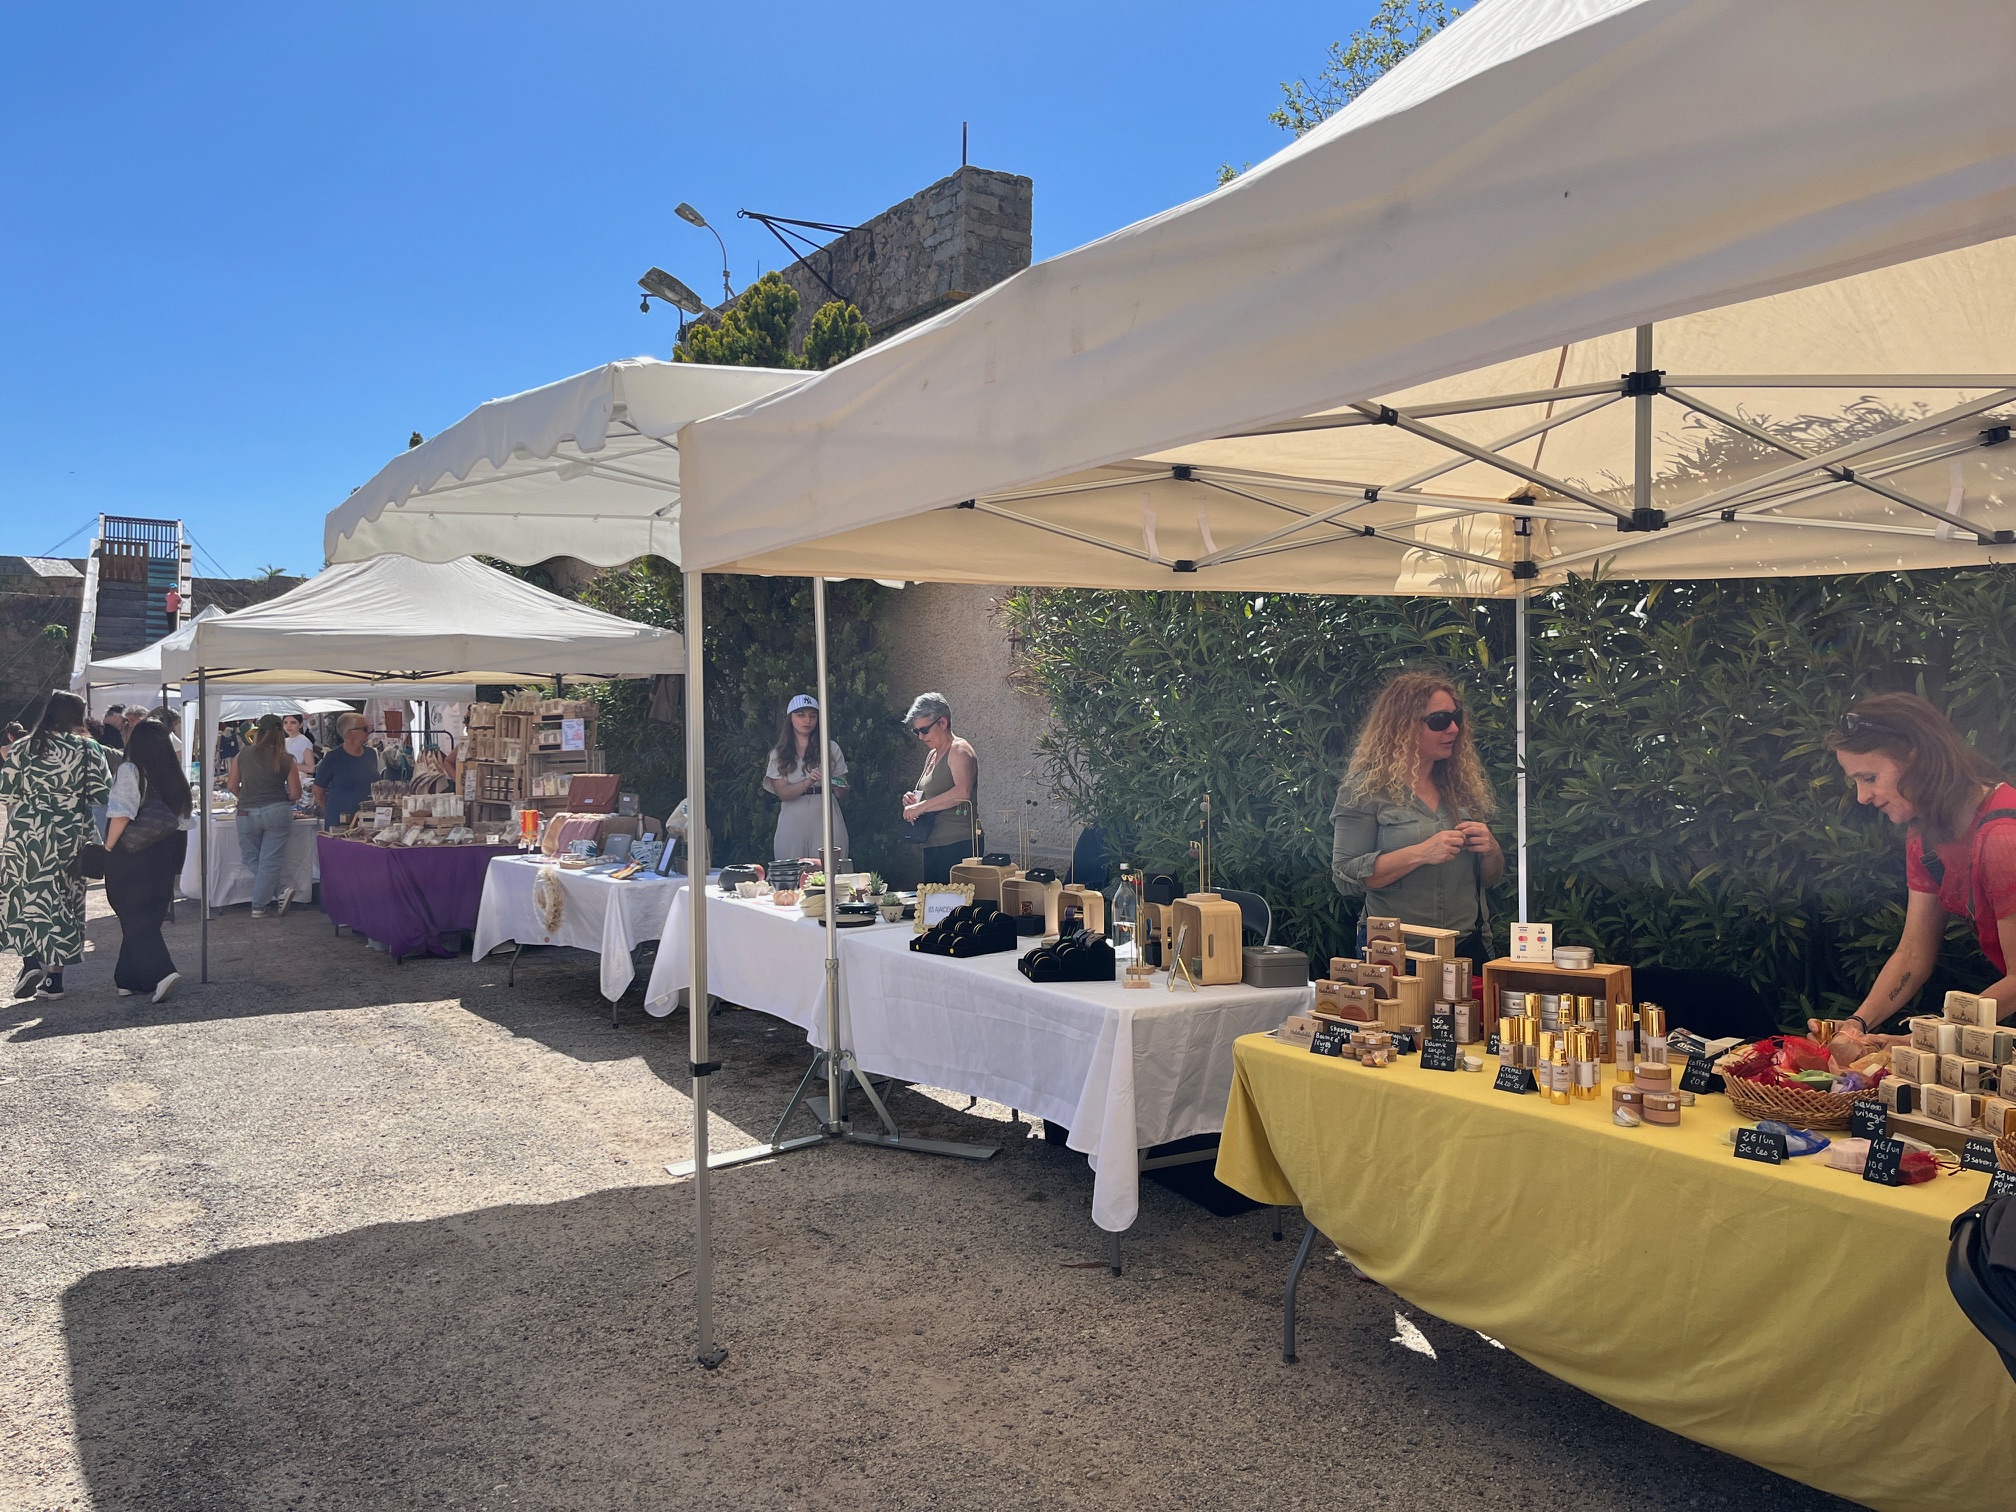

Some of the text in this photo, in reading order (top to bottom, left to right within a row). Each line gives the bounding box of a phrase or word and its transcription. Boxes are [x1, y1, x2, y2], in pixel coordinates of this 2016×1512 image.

[1855, 1109, 1887, 1124] visage
[1866, 1121, 1884, 1136] 5 €
[1755, 1146, 1769, 1156] les
[1771, 1149, 1779, 1160] 3
[1963, 1153, 1971, 1163] 3
[1881, 1172, 1889, 1181] 3
